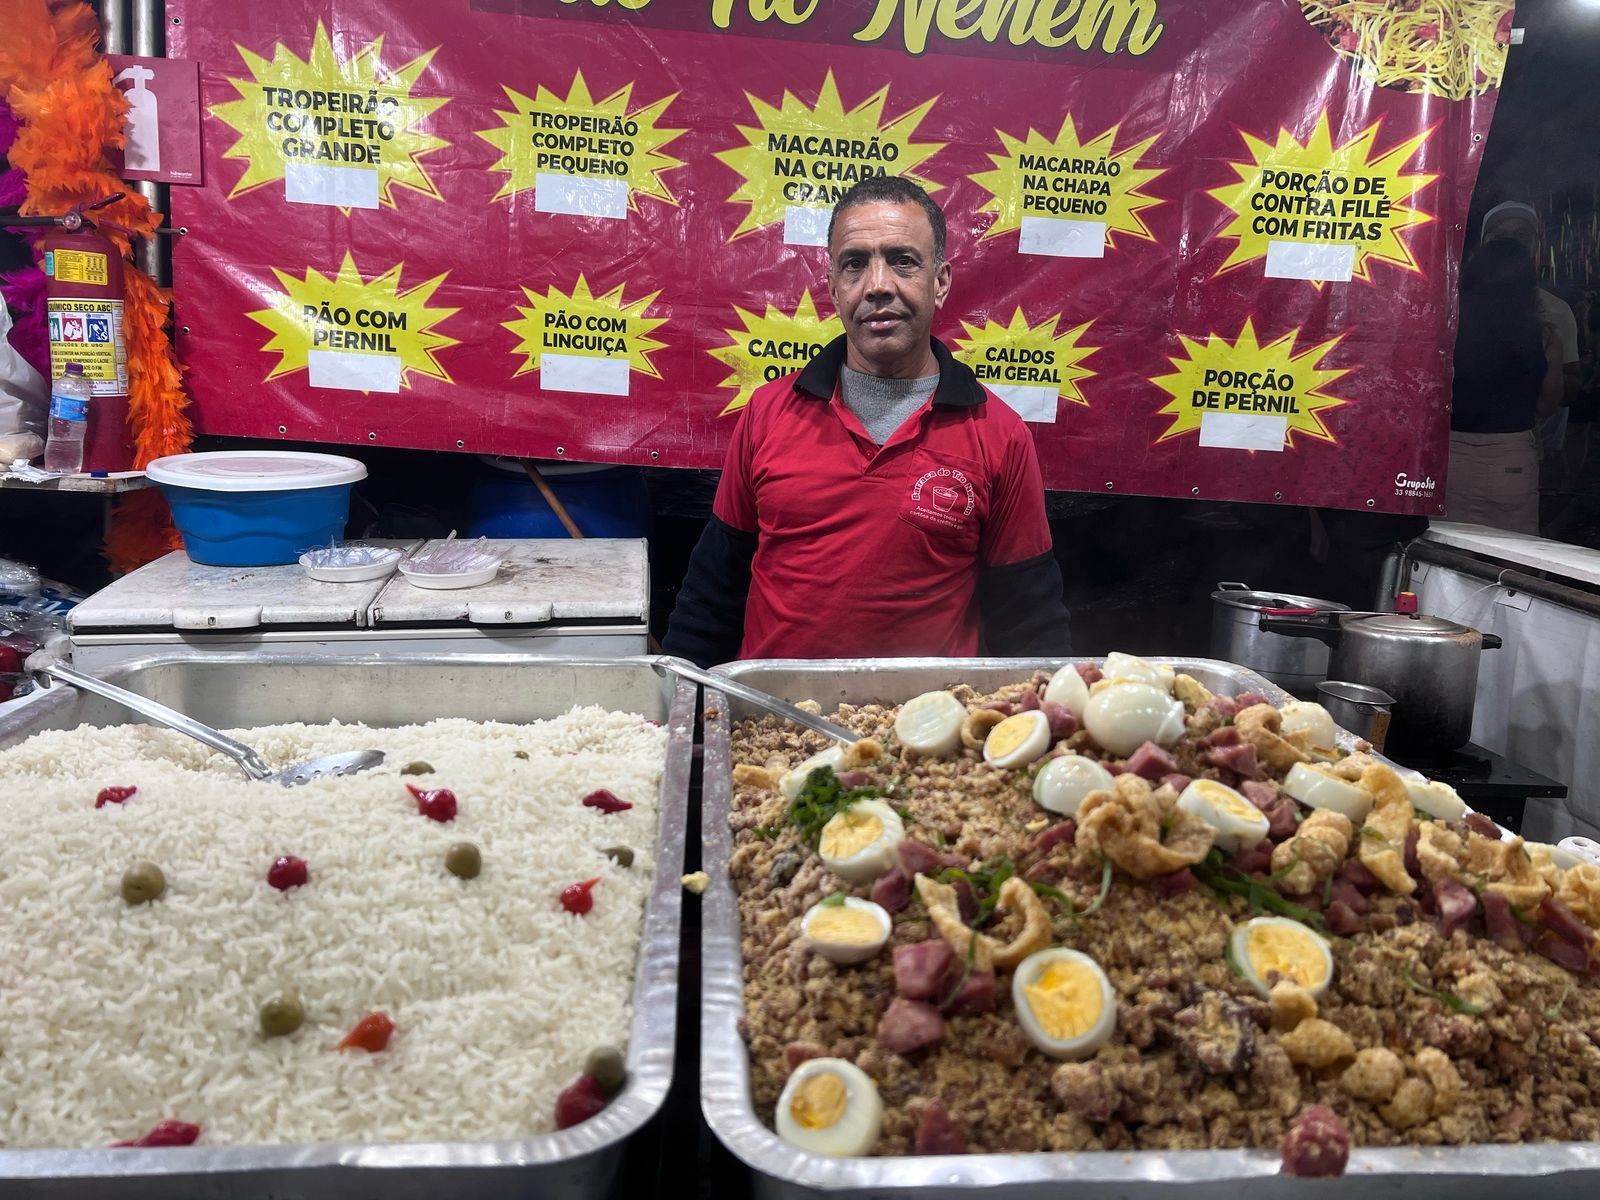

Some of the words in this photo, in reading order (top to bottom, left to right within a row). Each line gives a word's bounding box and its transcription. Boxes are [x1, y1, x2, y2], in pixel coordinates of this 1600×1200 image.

[262, 86, 399, 116] TROPEIRÃO
[267, 111, 395, 141] COMPLETO
[529, 111, 638, 137] TROPEIRÃO
[282, 137, 381, 165] GRANDE
[532, 132, 634, 156] COMPLETO
[767, 132, 899, 162] MACARRÃO
[537, 153, 628, 176] PEQUENO
[774, 157, 807, 178] NA
[812, 160, 888, 182] CHAPA
[1019, 154, 1121, 177] MACARRÃO
[783, 181, 852, 204] GRAN
[1023, 174, 1049, 191] NA
[1052, 177, 1111, 196] CHAPA
[1261, 169, 1349, 198] PORÇÃO
[1353, 177, 1387, 195] DE
[1023, 194, 1107, 216] PEQUENO
[1251, 192, 1336, 217] CONTRA
[1341, 195, 1391, 218] FILÉ
[1252, 215, 1299, 238] COM
[1302, 220, 1383, 241] FRITAS
[73, 303, 95, 312] SECO
[96, 304, 111, 312] ABC
[303, 301, 351, 326] PÃO
[355, 309, 407, 331] COM
[544, 309, 582, 330] PÃO
[585, 316, 627, 334] COM
[313, 329, 397, 353] PERNIL
[543, 332, 628, 356] LINGUIÇA
[748, 338, 824, 361] CACHO
[985, 346, 1056, 365] CALDOS
[975, 364, 1002, 380] EM
[1004, 365, 1062, 384] GERAL
[1203, 368, 1294, 395] PORÇÃO
[1191, 390, 1221, 409] DE
[1224, 392, 1300, 414] PERNIL
[912, 470, 937, 500] Barraca
[937, 467, 951, 477] do
[1394, 488, 1403, 496] 33
